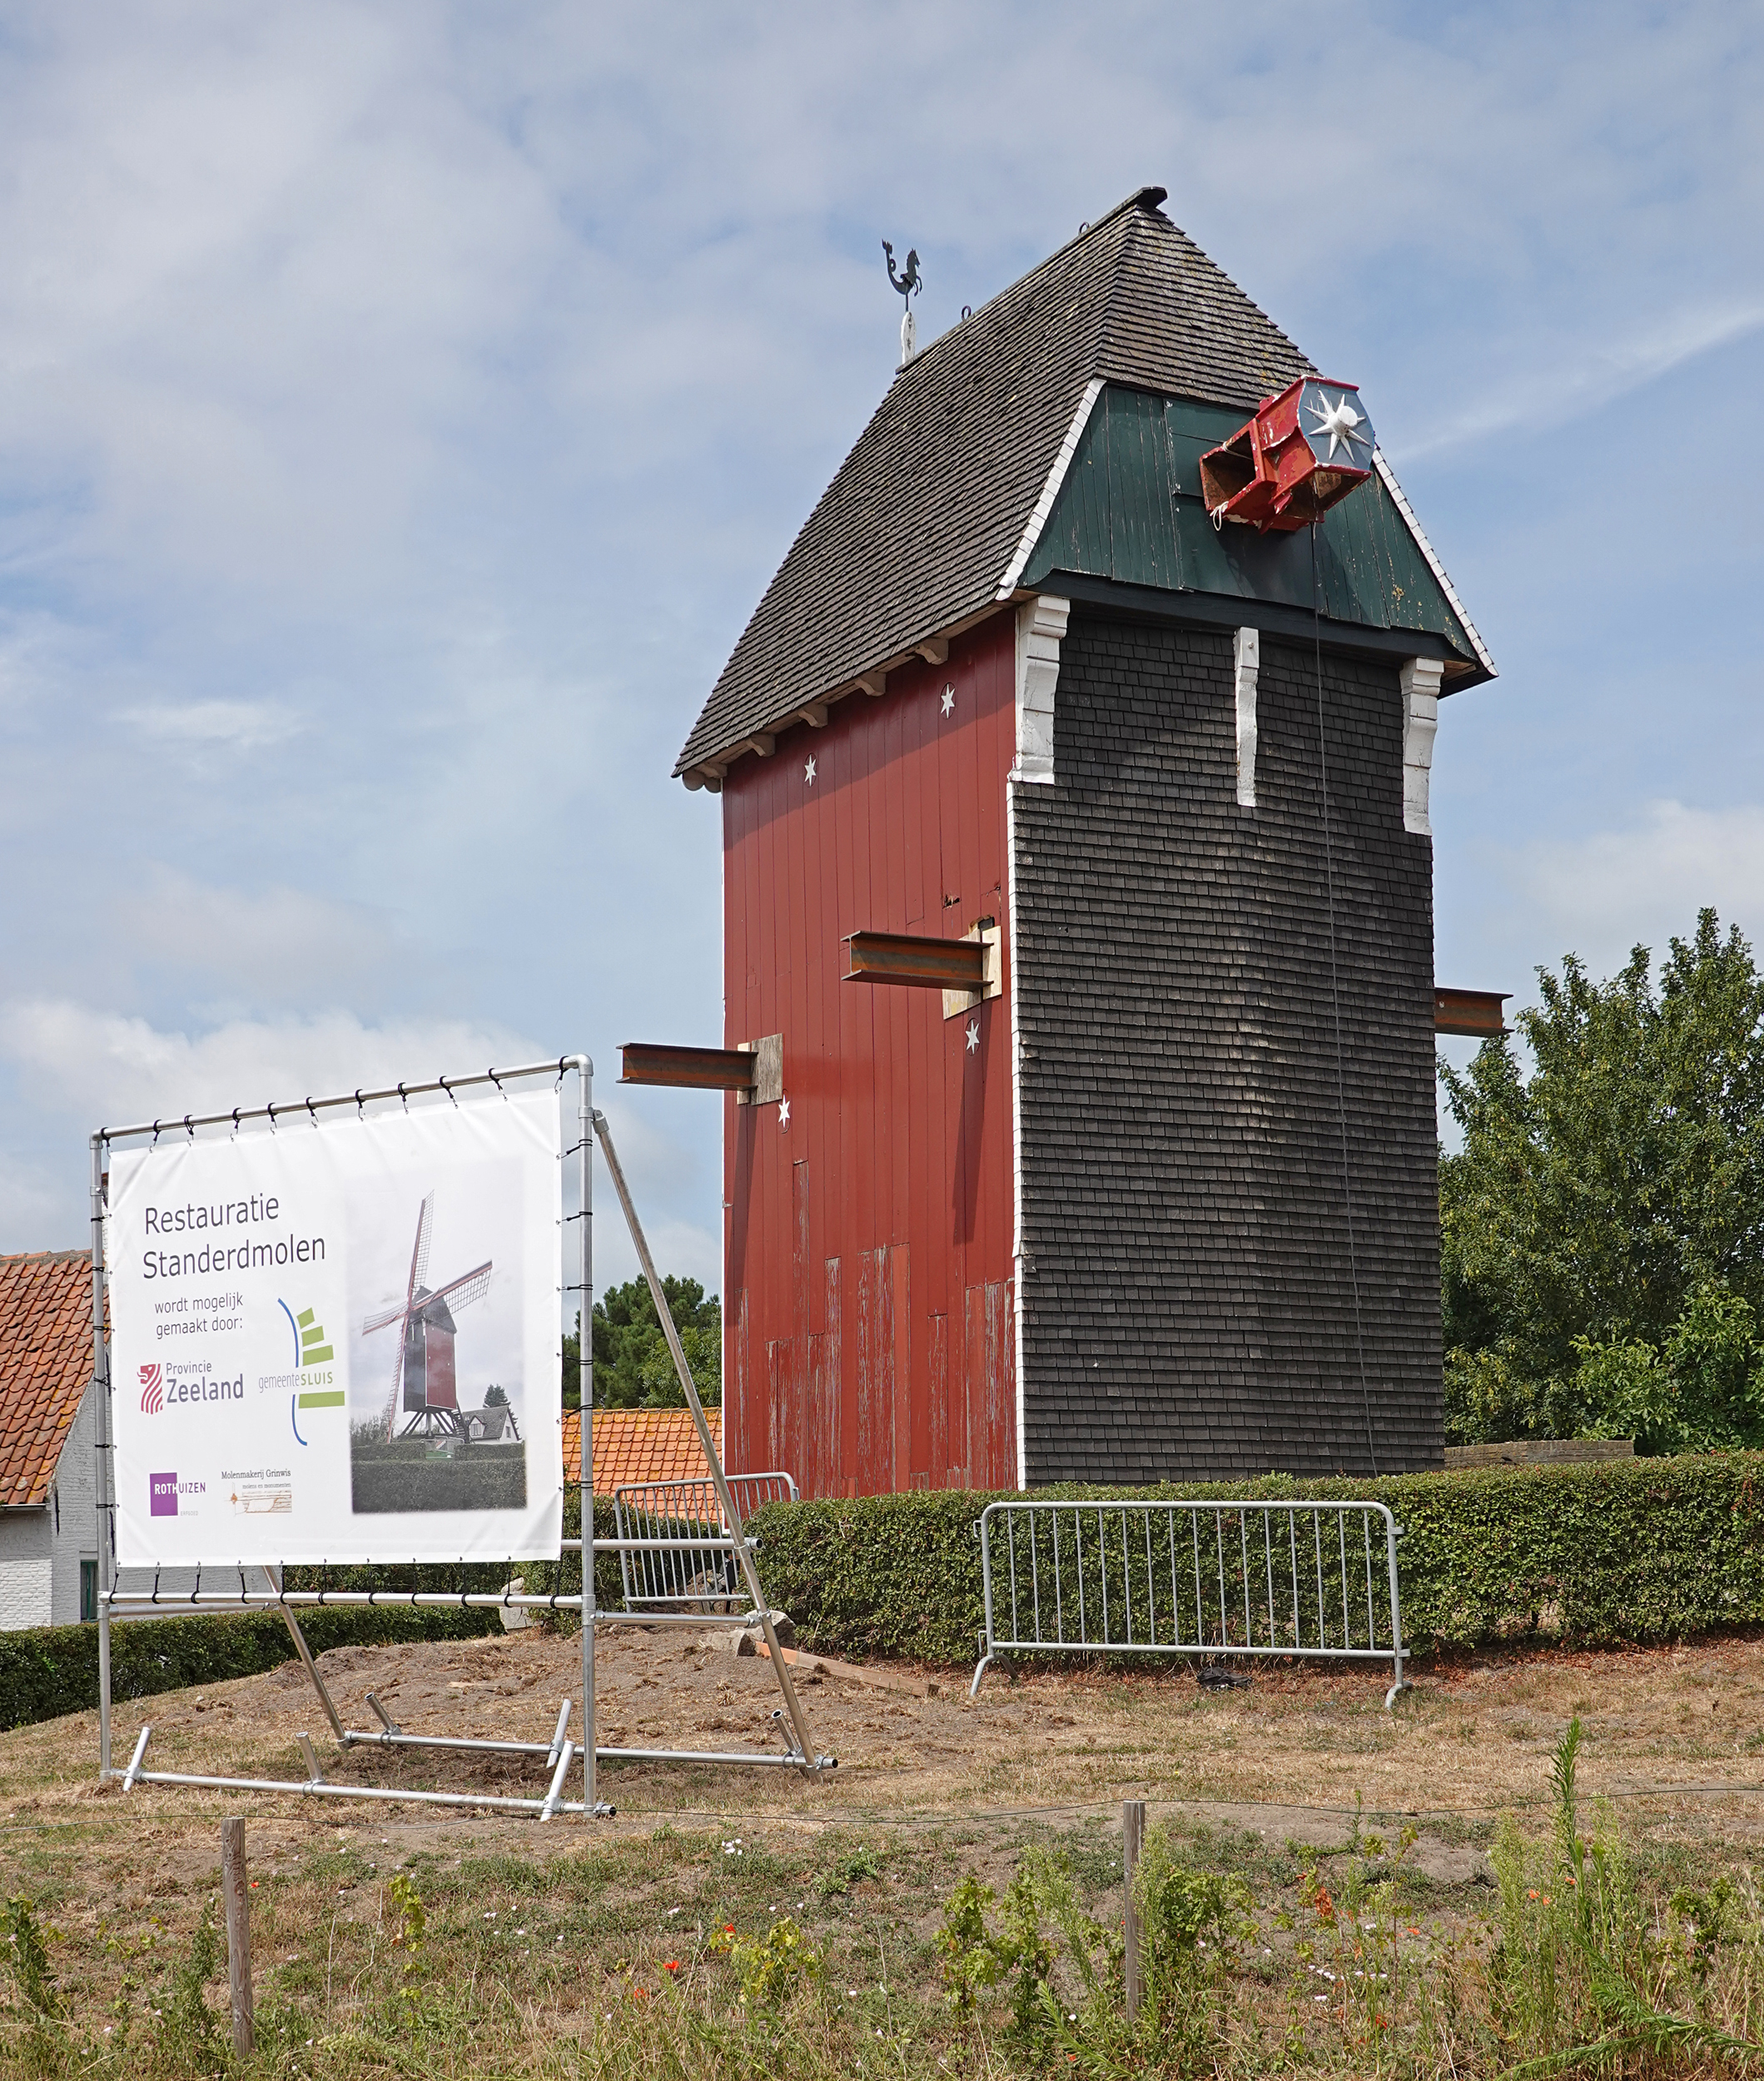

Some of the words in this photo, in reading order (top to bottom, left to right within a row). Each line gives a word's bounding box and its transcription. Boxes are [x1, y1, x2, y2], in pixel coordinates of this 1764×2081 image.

[145, 1193, 280, 1234] Restauratie
[143, 1233, 325, 1279] Standerdmolen
[155, 1297, 189, 1314] wordt
[192, 1291, 244, 1313] mogelijk
[156, 1319, 208, 1339] gemaakt
[211, 1317, 243, 1332] door:
[166, 1360, 212, 1375] Provincie
[166, 1373, 244, 1403] Zeeland
[221, 1470, 265, 1480] Molenmakerij
[266, 1468, 291, 1478] Grinwis
[154, 1482, 206, 1495] ROTHUIZEN
